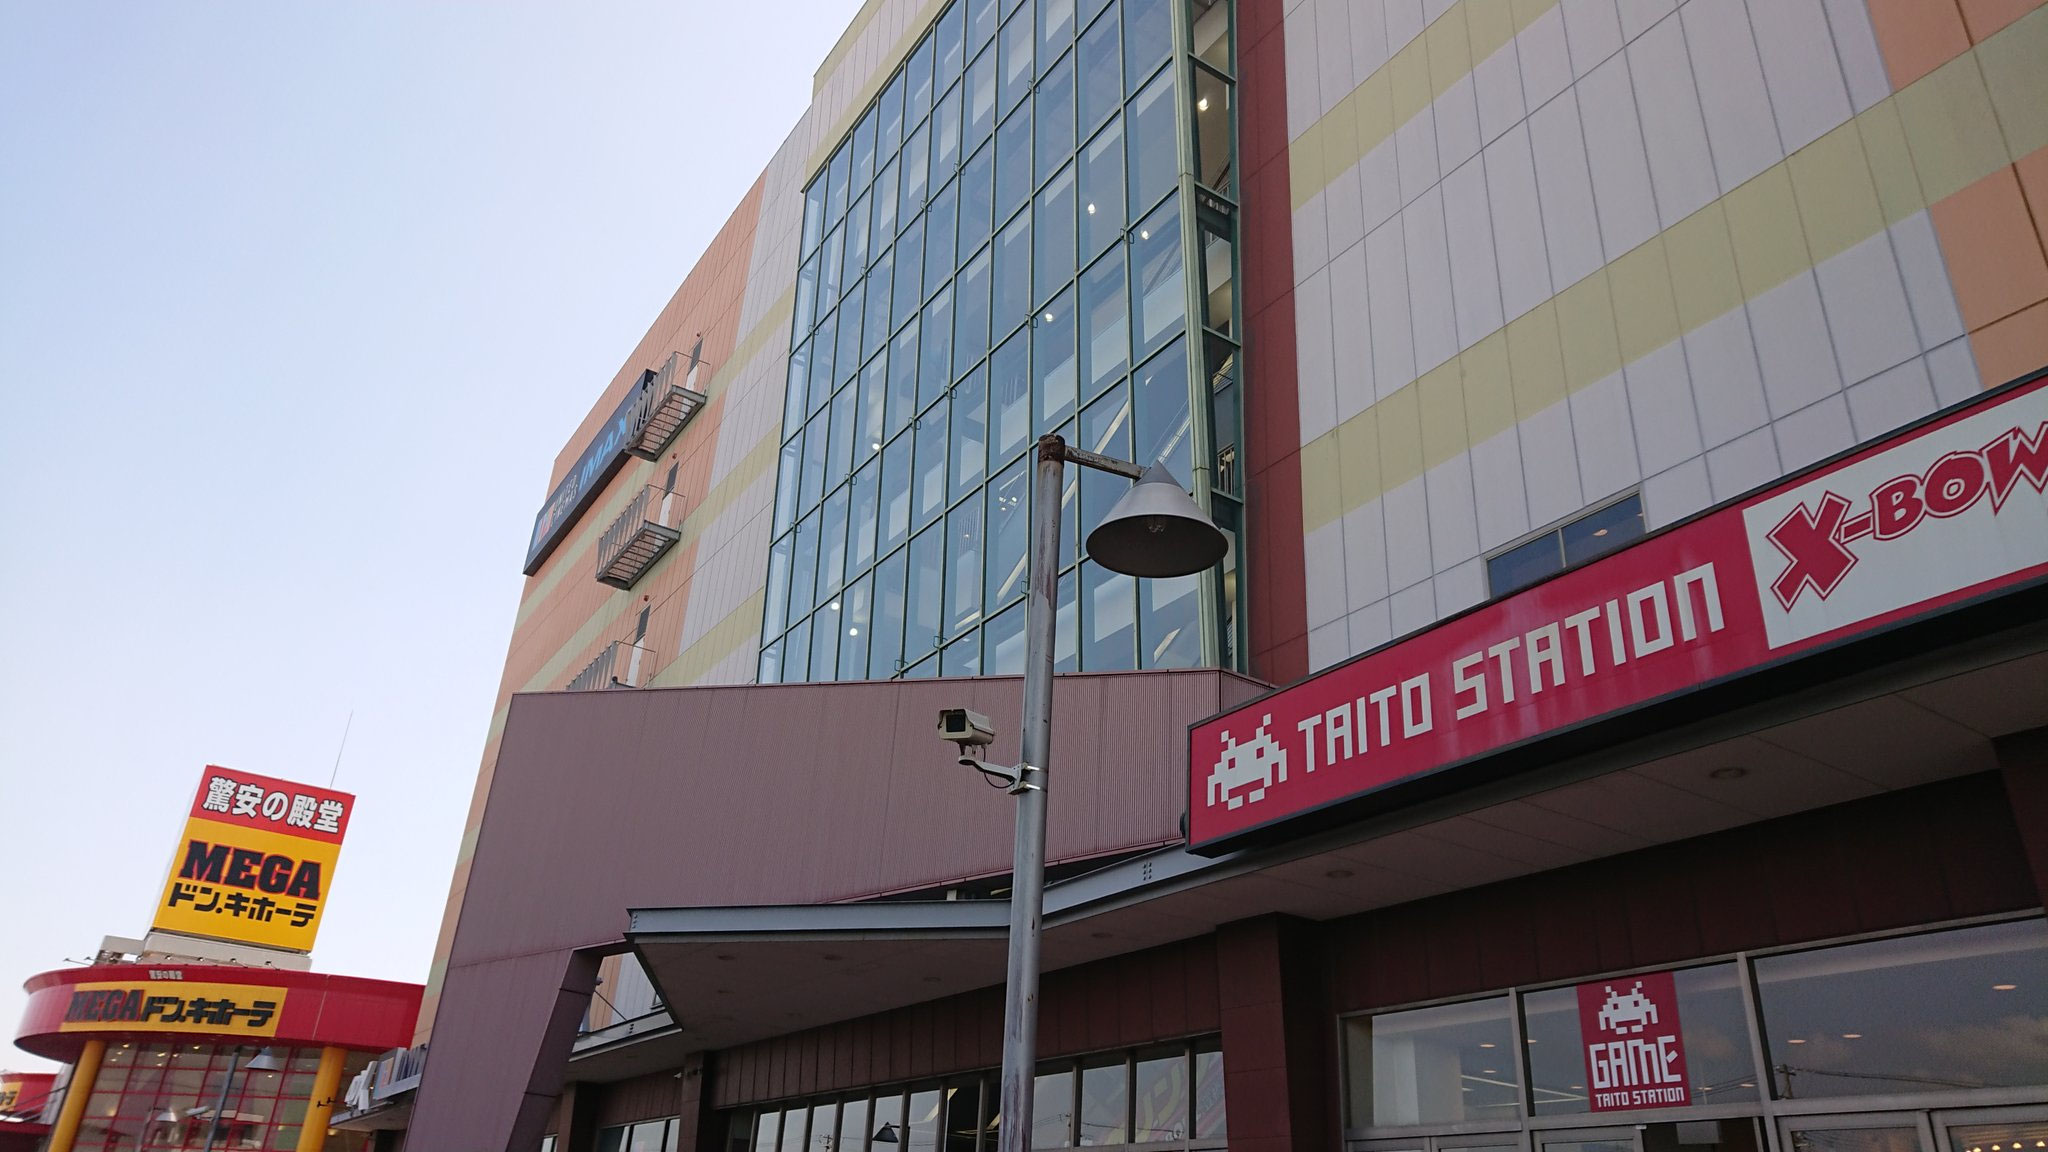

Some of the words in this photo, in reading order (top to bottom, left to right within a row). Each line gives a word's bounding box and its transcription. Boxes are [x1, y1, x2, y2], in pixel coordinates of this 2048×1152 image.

[578, 415, 627, 490] IMAX
[1297, 672, 1433, 773] TAITO
[1453, 562, 1725, 721] STATION
[202, 776, 343, 833] 驚安の殿堂
[178, 839, 321, 901] MEGA
[1589, 1035, 1682, 1089] GAME
[1595, 1091, 1630, 1108] TAITO
[1632, 1087, 1685, 1105] STATION
